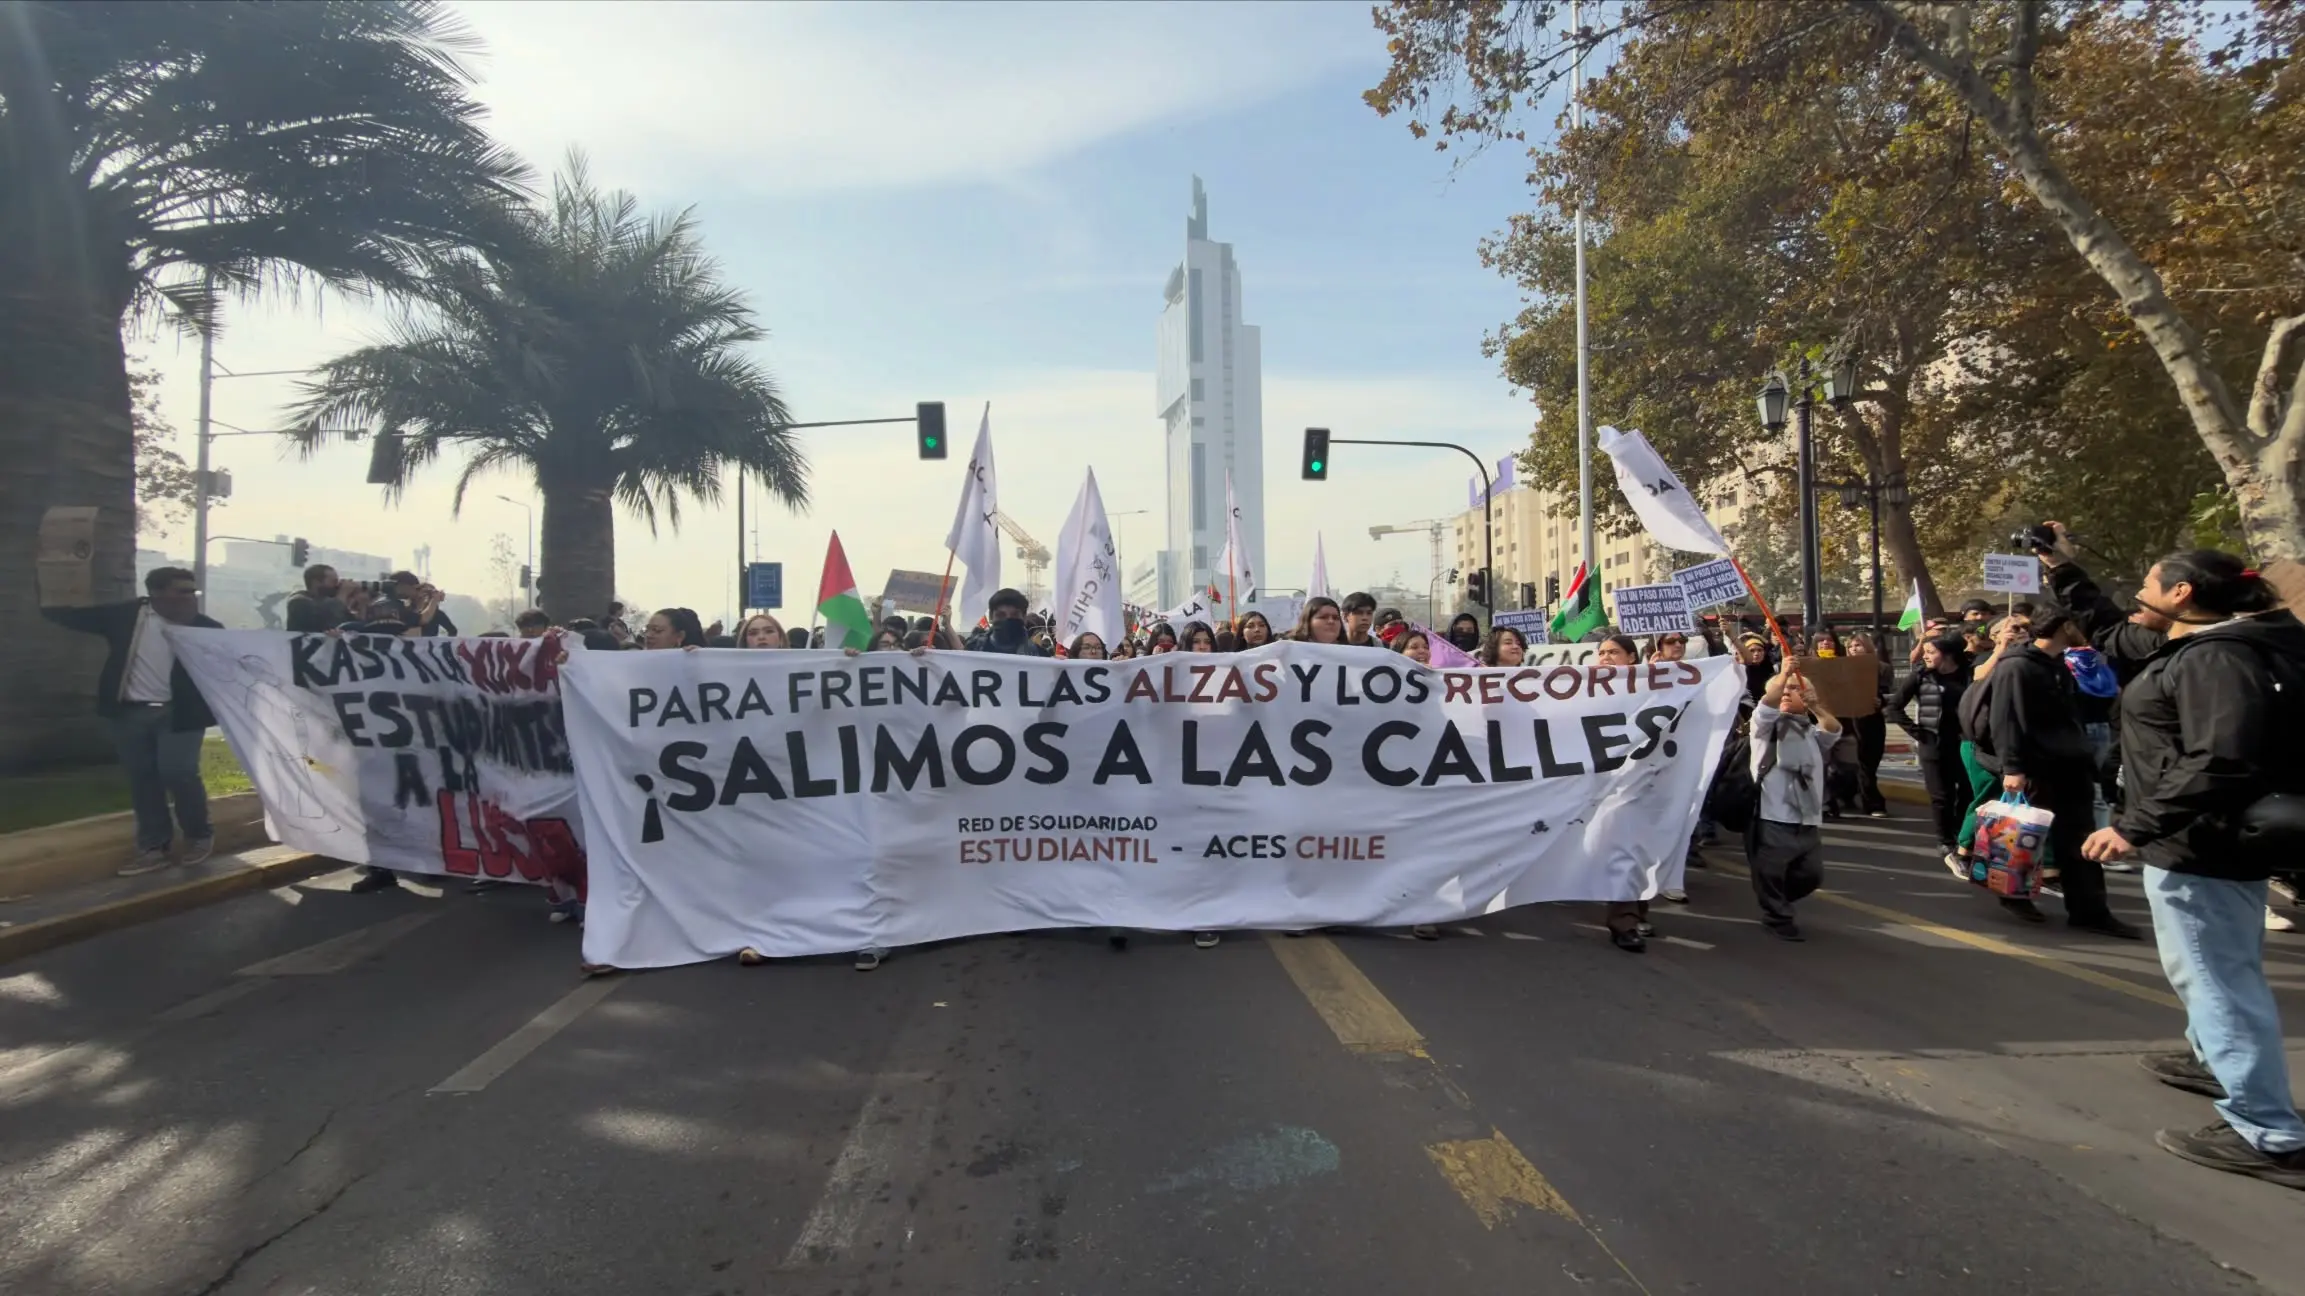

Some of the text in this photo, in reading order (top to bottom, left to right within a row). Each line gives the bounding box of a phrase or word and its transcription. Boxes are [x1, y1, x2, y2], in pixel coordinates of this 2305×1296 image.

[1067, 580, 1098, 633] CHILE
[1620, 600, 1686, 616] CIEN PASOS HACIA
[1639, 589, 1658, 600] PASO
[1623, 614, 1690, 633] ADELANTE!
[629, 662, 1702, 728] PARA FRENAR LAS ALZAS Y LOS RECORTES
[394, 752, 432, 808] A
[633, 702, 1690, 845] ¡SALIMOS A LAS CALLES!
[957, 814, 1159, 834] RED DE SOLIDARIDAD
[959, 836, 1158, 865] ESTUDIANTIL
[1202, 834, 1288, 860] ACES
[1295, 835, 1386, 861] CHILE
